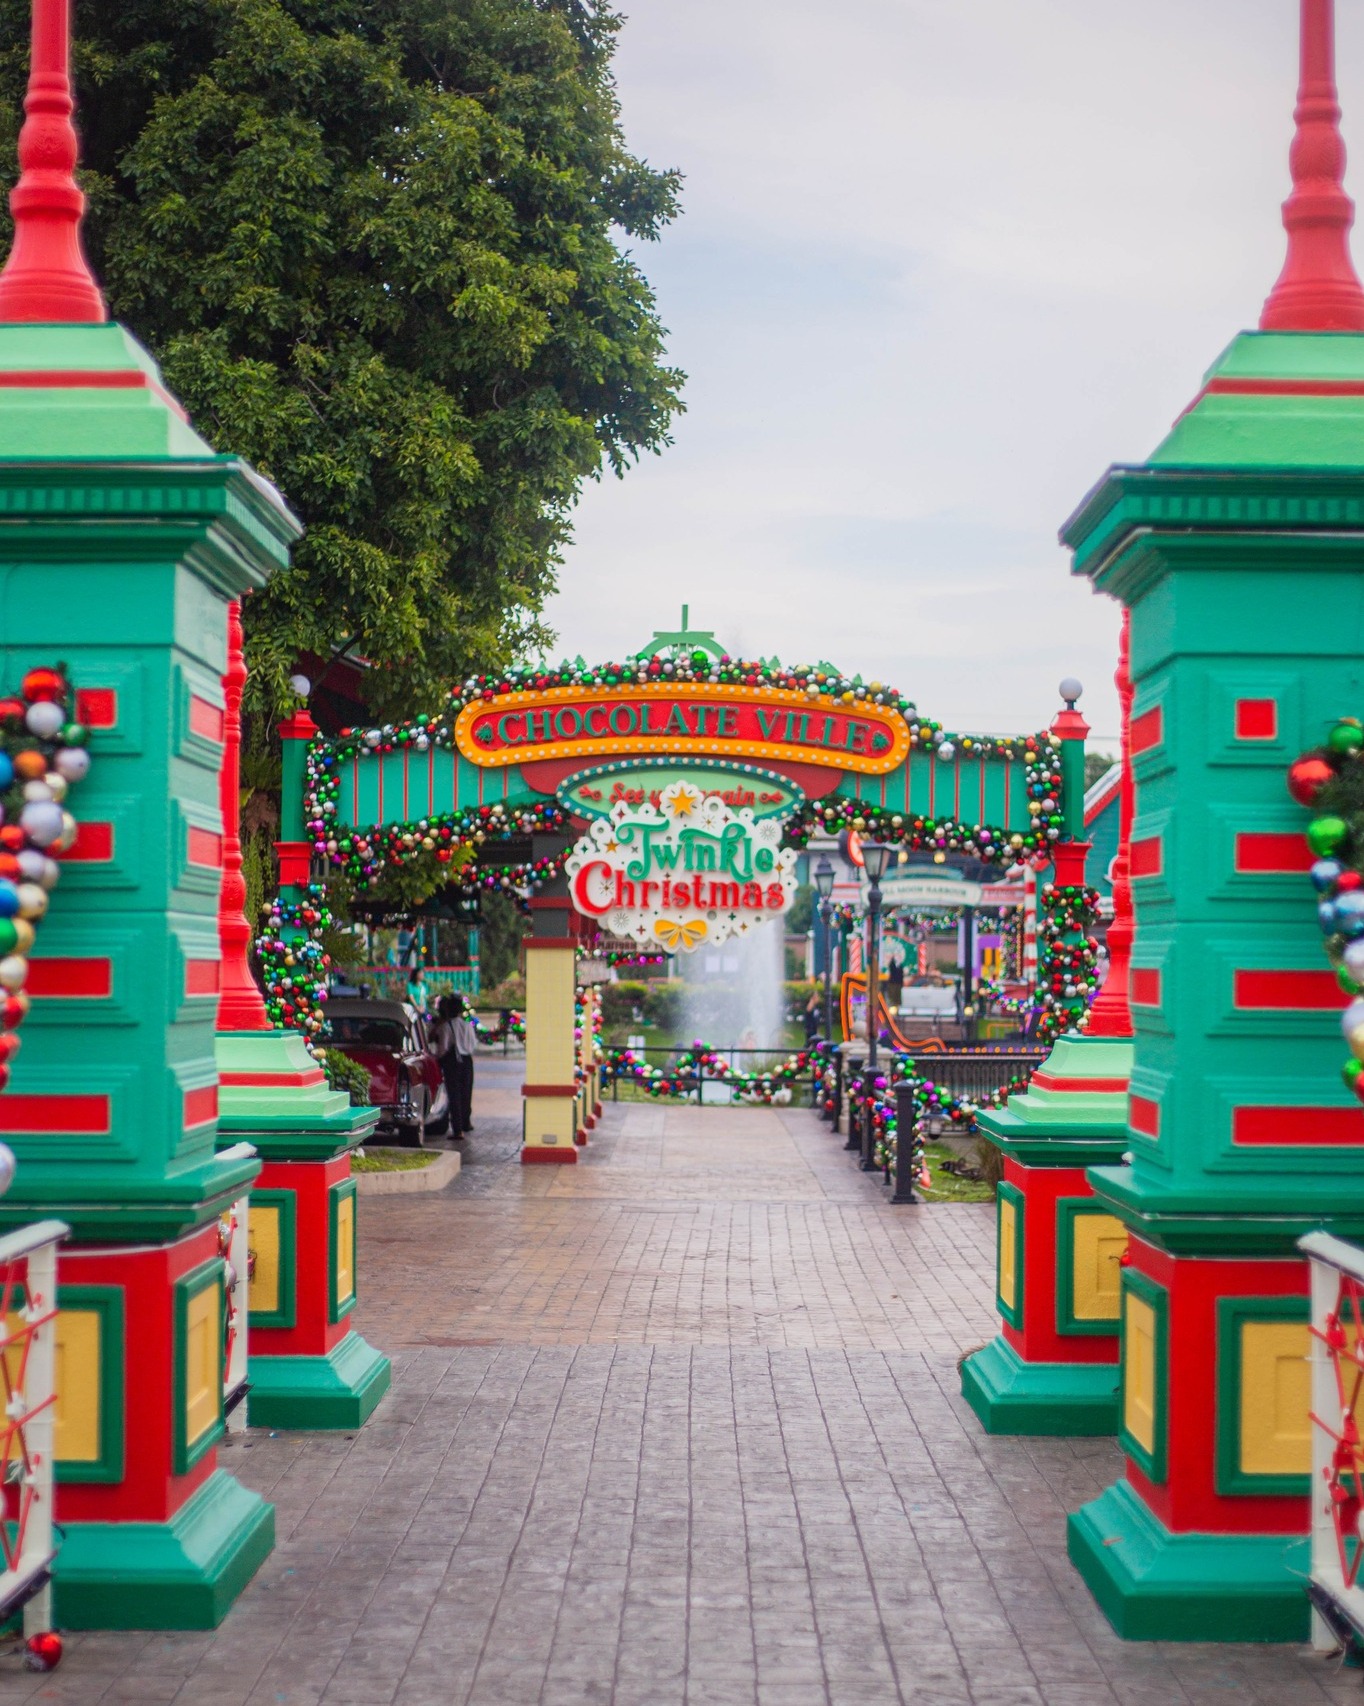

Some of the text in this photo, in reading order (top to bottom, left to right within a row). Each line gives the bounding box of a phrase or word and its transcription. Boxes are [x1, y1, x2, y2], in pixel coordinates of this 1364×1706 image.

[497, 703, 870, 752] CHOCOLATE VILLE
[609, 782, 646, 805] See
[700, 784, 755, 806] ain
[615, 818, 774, 883] Twinkle
[574, 860, 785, 914] Christmas
